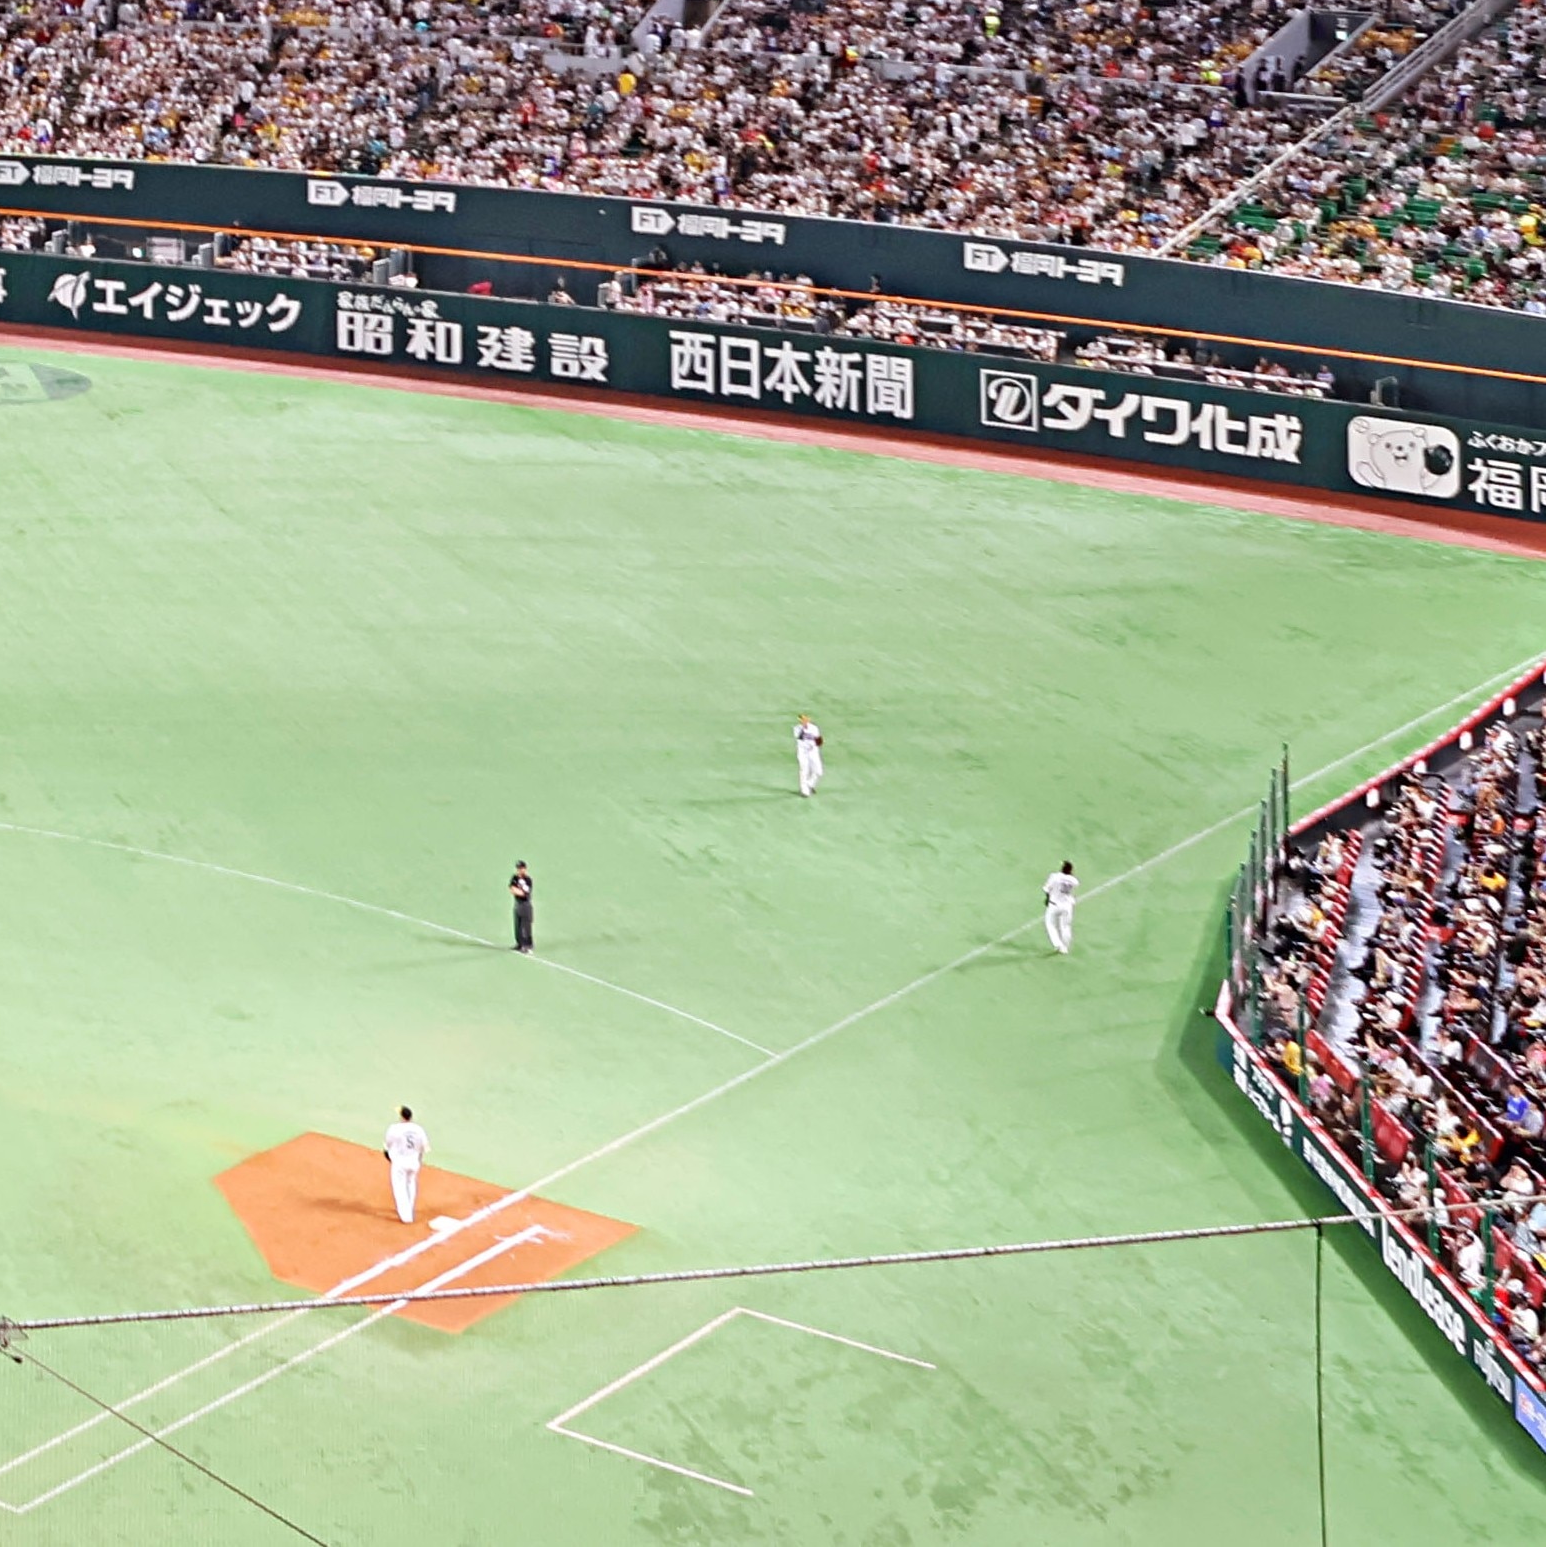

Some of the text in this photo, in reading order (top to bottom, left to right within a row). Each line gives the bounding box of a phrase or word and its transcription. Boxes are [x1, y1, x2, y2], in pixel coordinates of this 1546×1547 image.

[92, 275, 303, 334] エイジェック
[335, 309, 609, 382] 昭和建設
[669, 329, 915, 421] 西日本新聞
[1042, 383, 1303, 464] ダイワ化成
